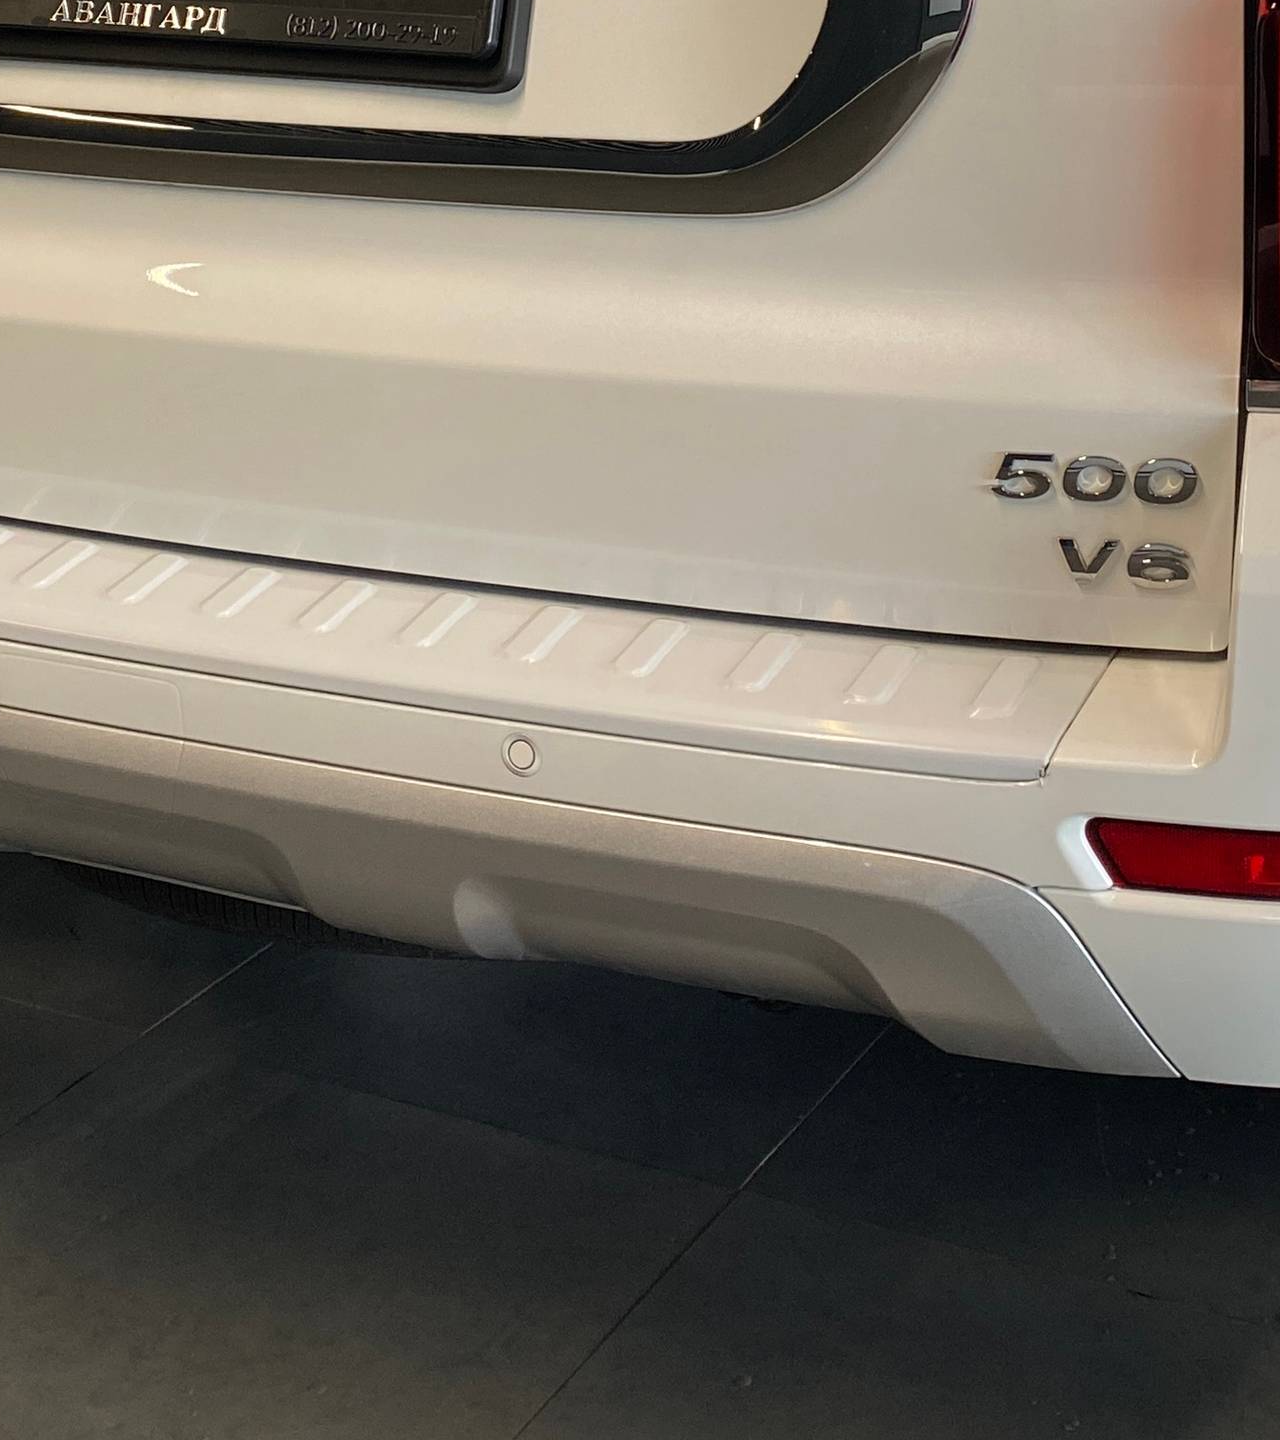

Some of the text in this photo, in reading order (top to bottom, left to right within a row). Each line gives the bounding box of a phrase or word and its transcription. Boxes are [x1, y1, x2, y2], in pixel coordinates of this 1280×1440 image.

[285, 13, 339, 40] (812)
[990, 452, 1198, 504] 500
[1058, 538, 1191, 589] V6
